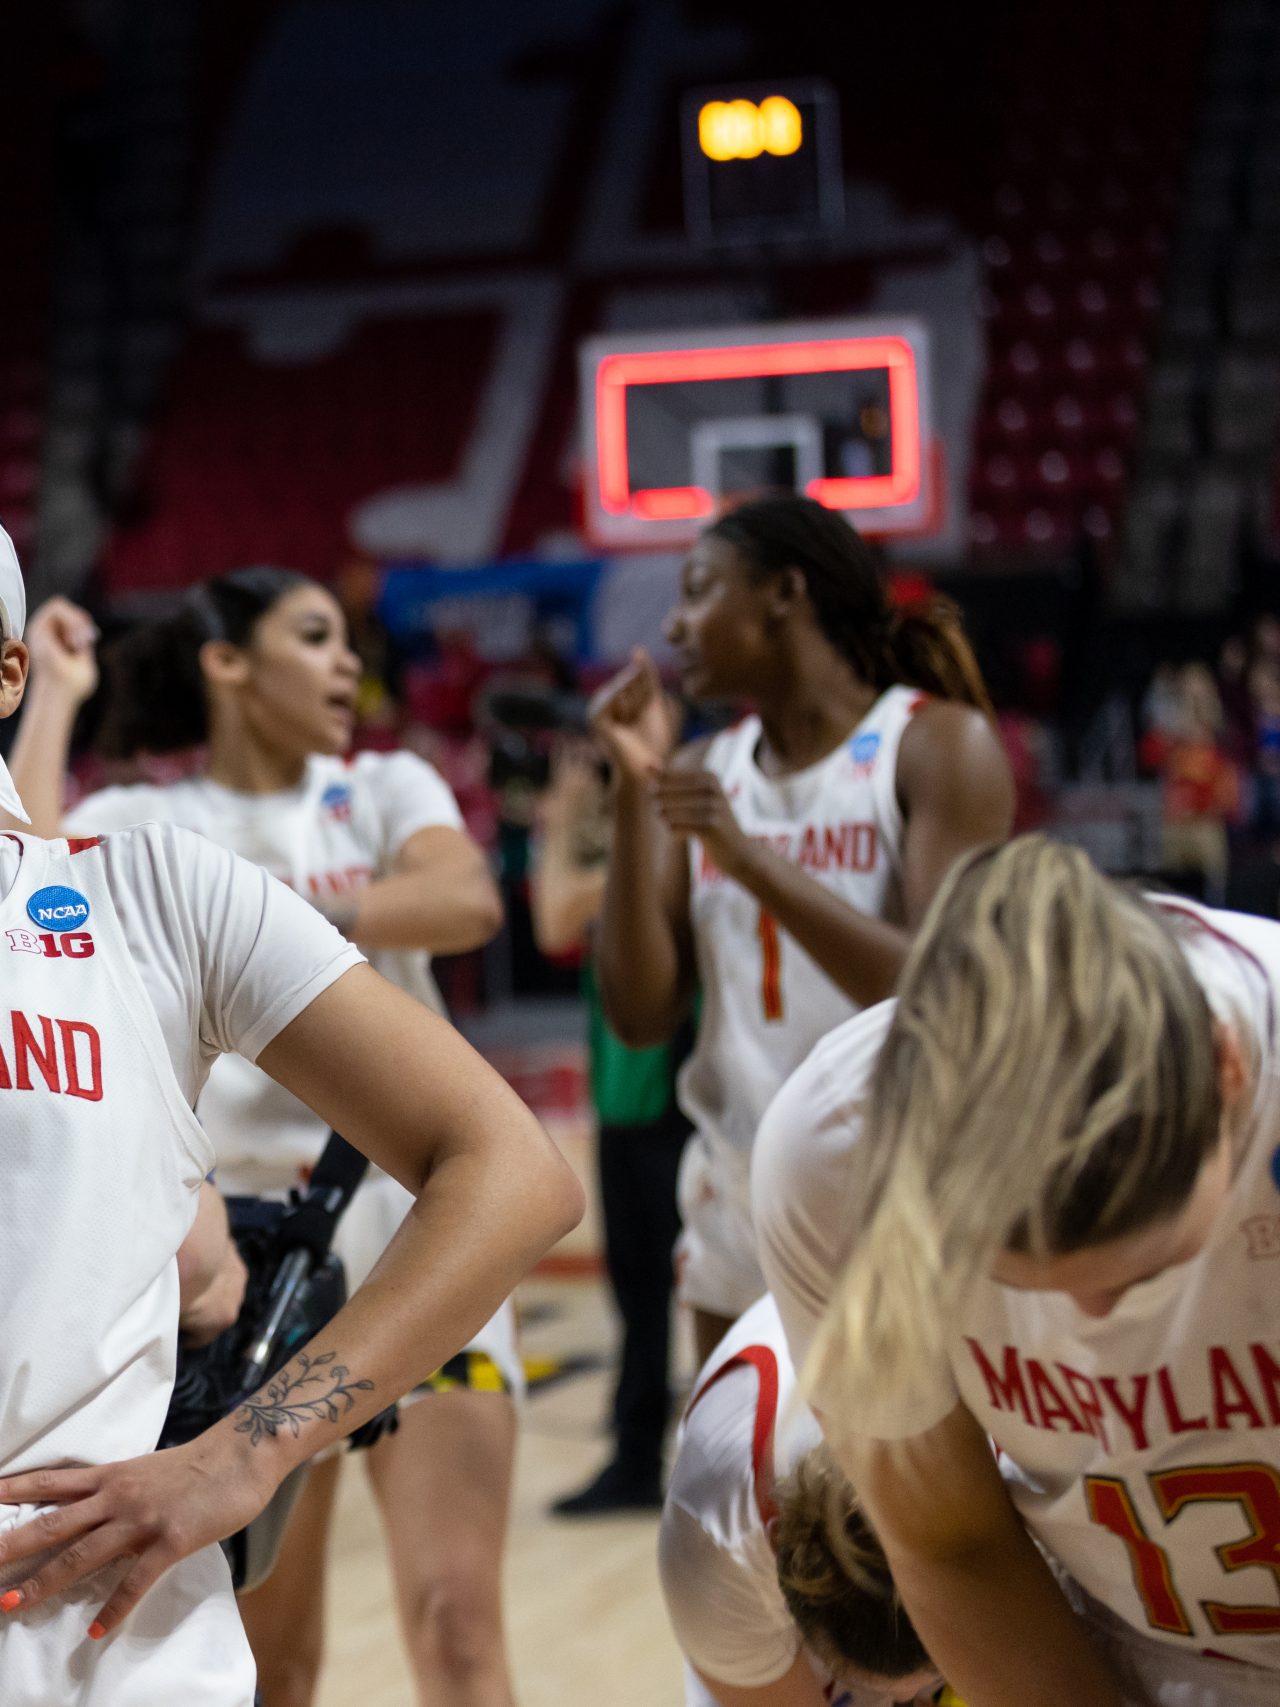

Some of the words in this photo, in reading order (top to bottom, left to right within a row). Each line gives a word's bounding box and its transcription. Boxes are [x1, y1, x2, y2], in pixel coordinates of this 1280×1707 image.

[37, 904, 87, 920] NCAA
[757, 905, 785, 1022] 1
[1084, 1461, 1280, 1639] 13
